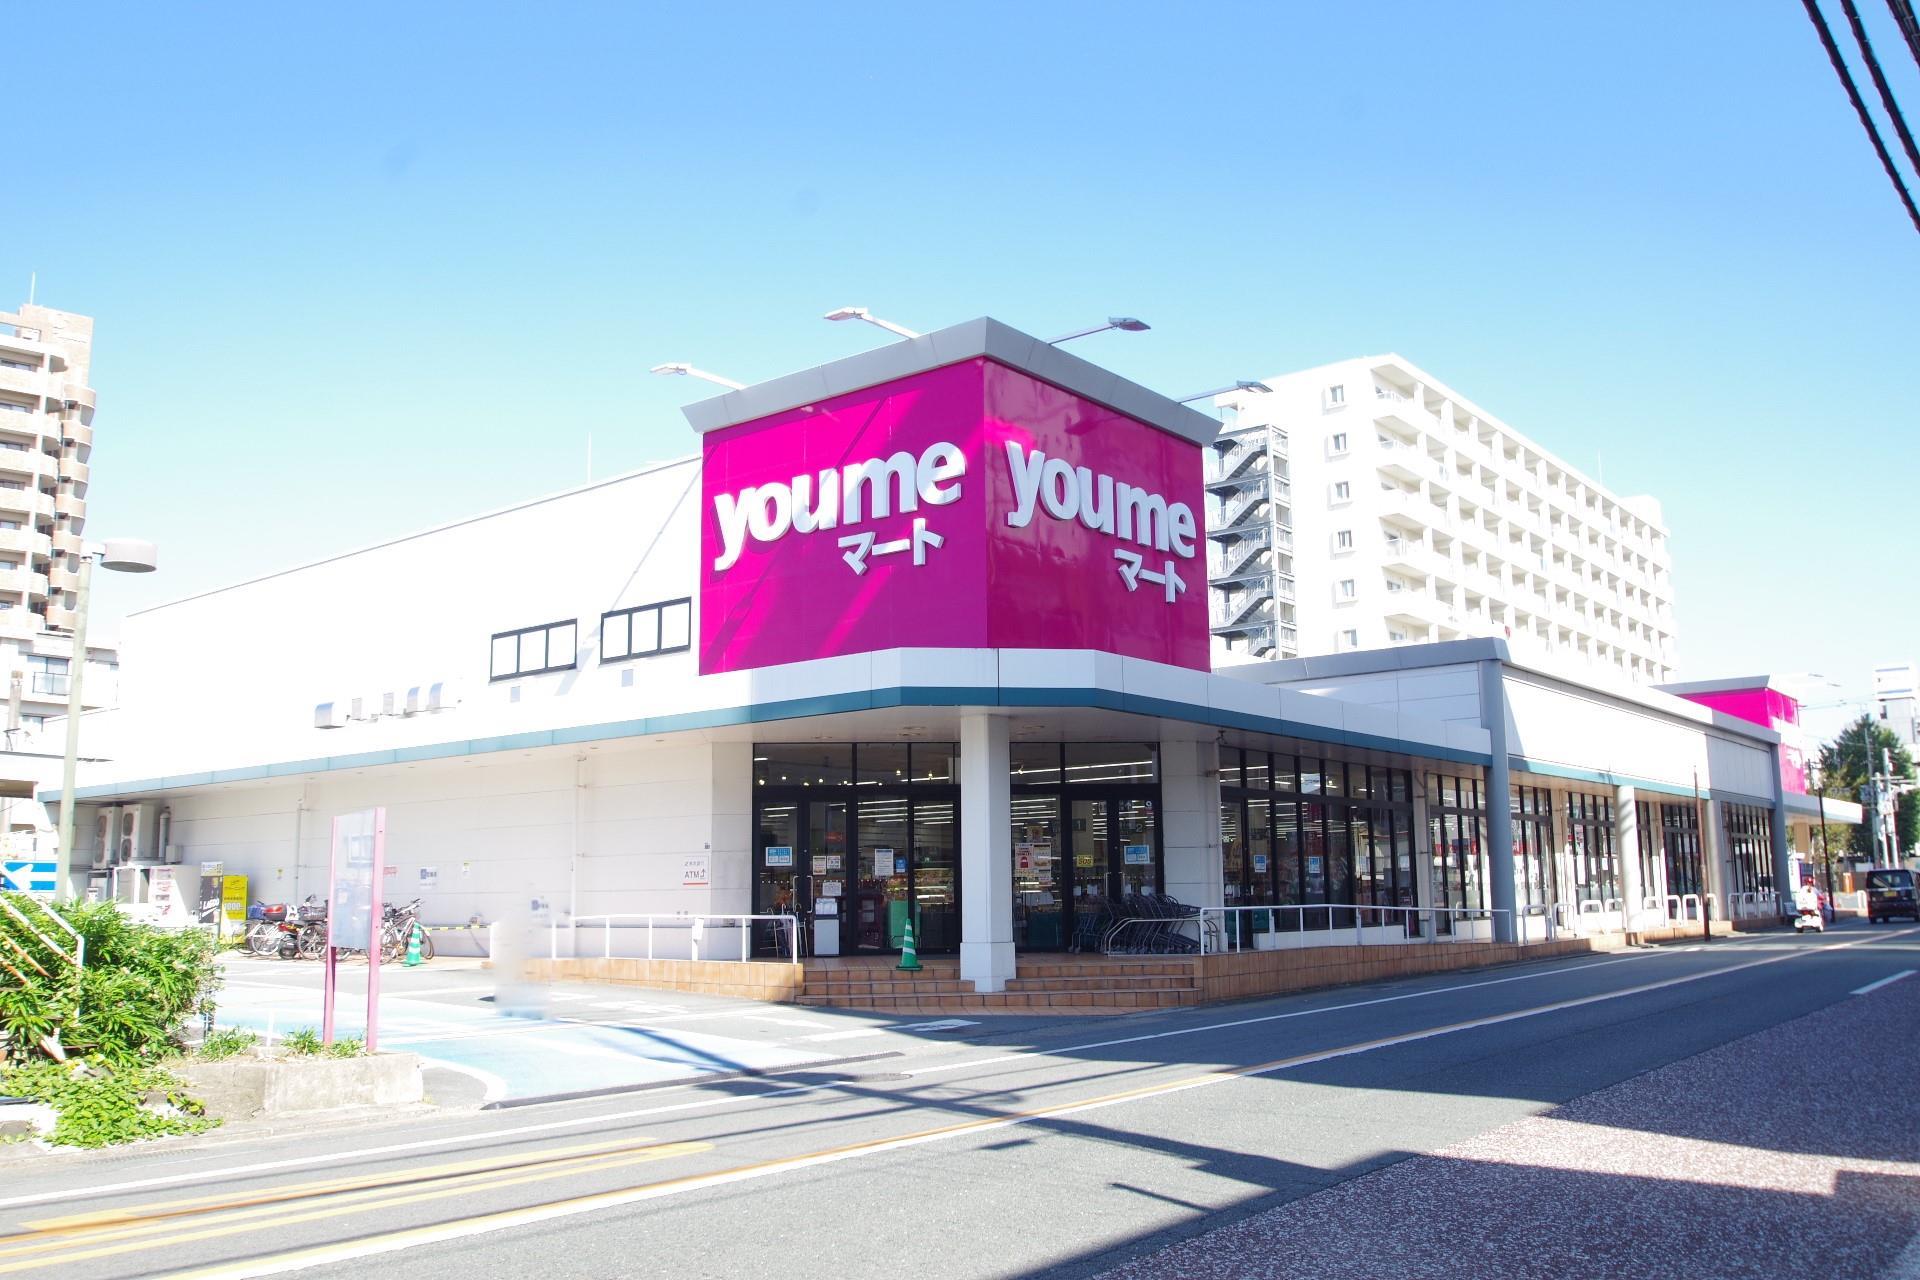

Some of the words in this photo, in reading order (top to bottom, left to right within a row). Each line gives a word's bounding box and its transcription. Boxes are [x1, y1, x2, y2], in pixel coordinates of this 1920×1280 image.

[713, 441, 966, 572] youme
[1004, 440, 1196, 559] youme
[837, 517, 944, 576] マート
[1113, 548, 1187, 604] マート
[684, 870, 700, 878] ATM
